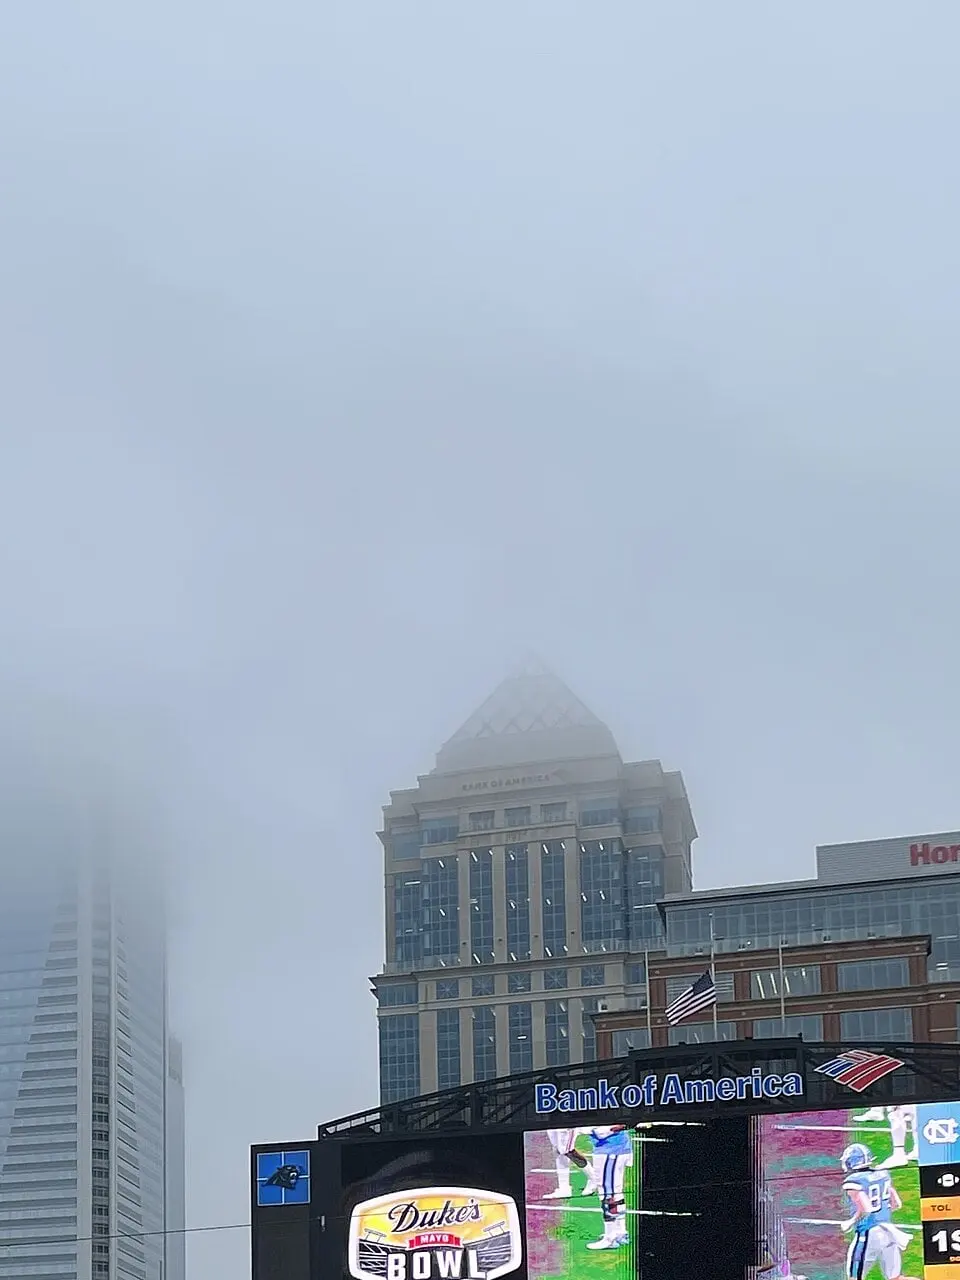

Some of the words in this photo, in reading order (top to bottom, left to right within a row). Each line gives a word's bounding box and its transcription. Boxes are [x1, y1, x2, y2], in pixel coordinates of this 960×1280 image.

[535, 1080, 619, 1114] Bank
[620, 1068, 658, 1109] of
[660, 1069, 803, 1106] America
[388, 1199, 482, 1233] Duke's
[420, 1234, 450, 1245] MAYO
